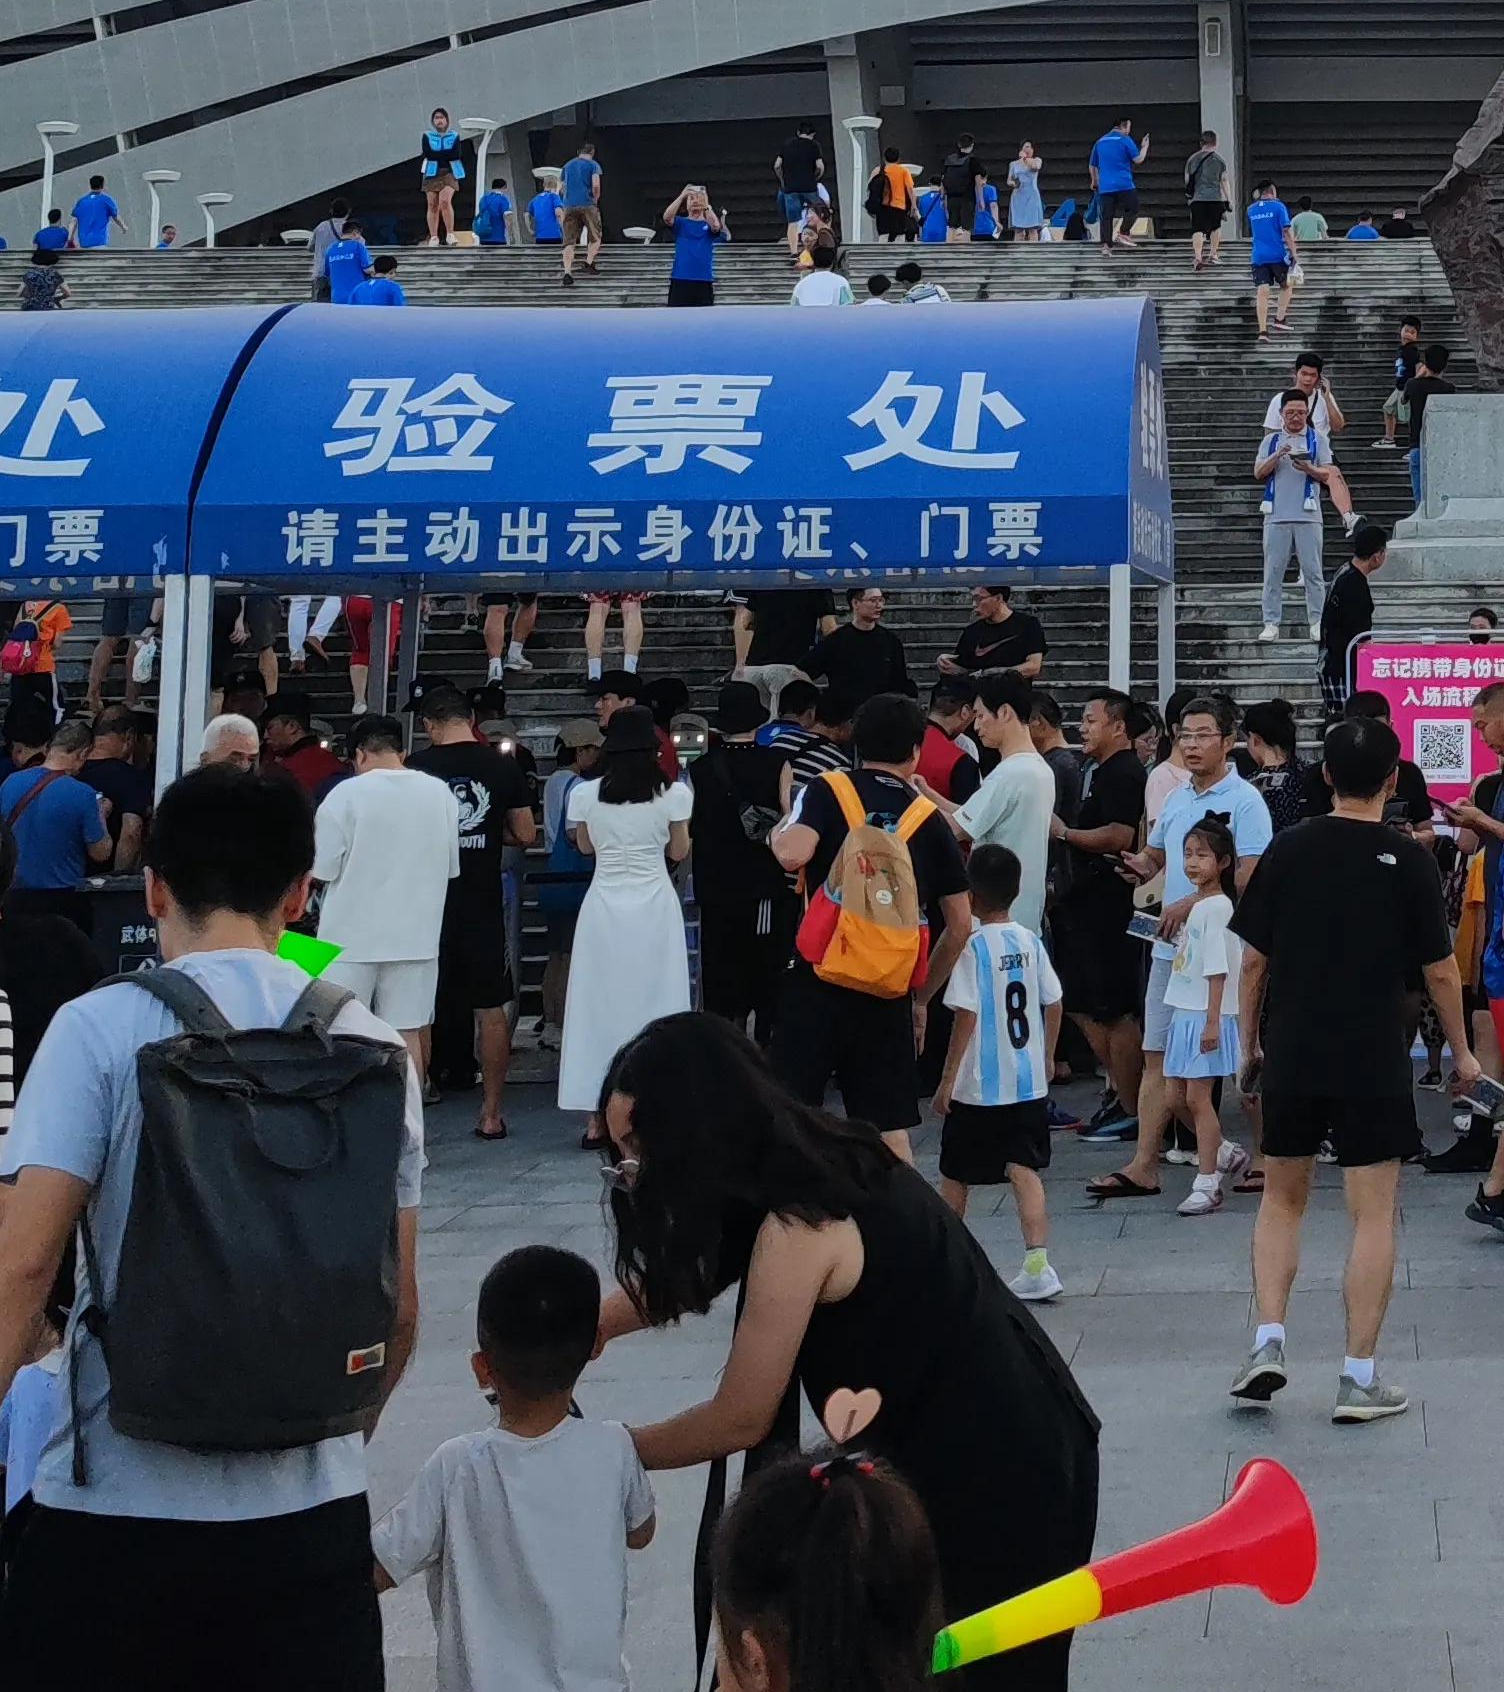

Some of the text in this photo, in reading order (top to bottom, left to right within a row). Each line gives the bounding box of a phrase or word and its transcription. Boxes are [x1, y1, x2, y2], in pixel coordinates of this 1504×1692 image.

[319, 371, 1023, 476] 验票处
[281, 501, 1044, 567] 请主动出示身份证、门票
[998, 951, 1031, 972] JERRY
[1005, 980, 1030, 1050] 8
